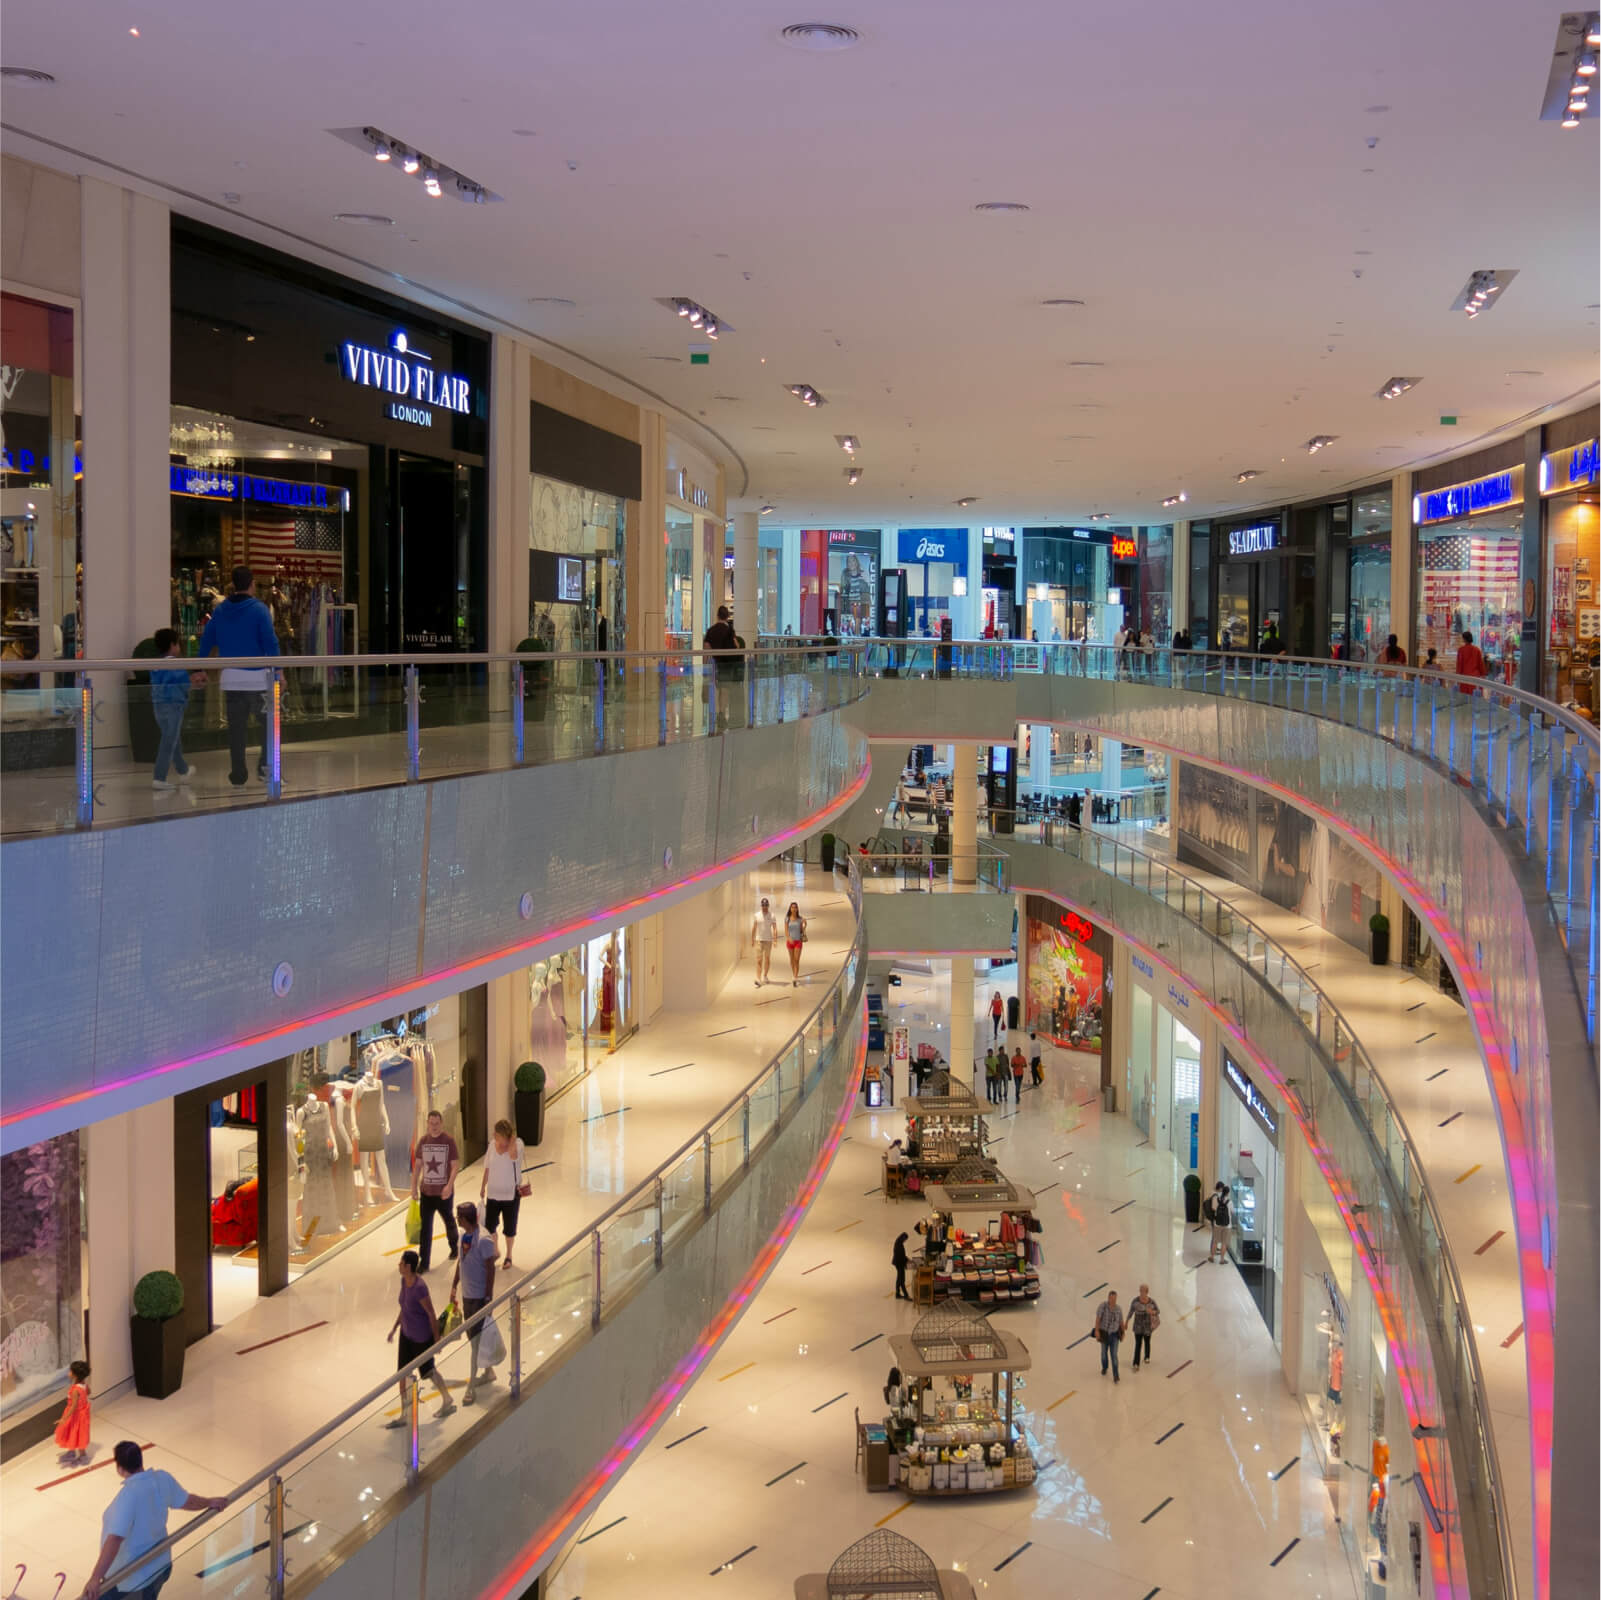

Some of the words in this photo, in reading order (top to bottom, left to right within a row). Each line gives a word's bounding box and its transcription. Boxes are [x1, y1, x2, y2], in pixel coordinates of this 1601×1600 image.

[346, 343, 410, 395] VIVID
[416, 365, 470, 415] FLAIR
[392, 402, 432, 427] LONDON
[406, 634, 428, 642] VIVID
[430, 635, 452, 643] FLAIR
